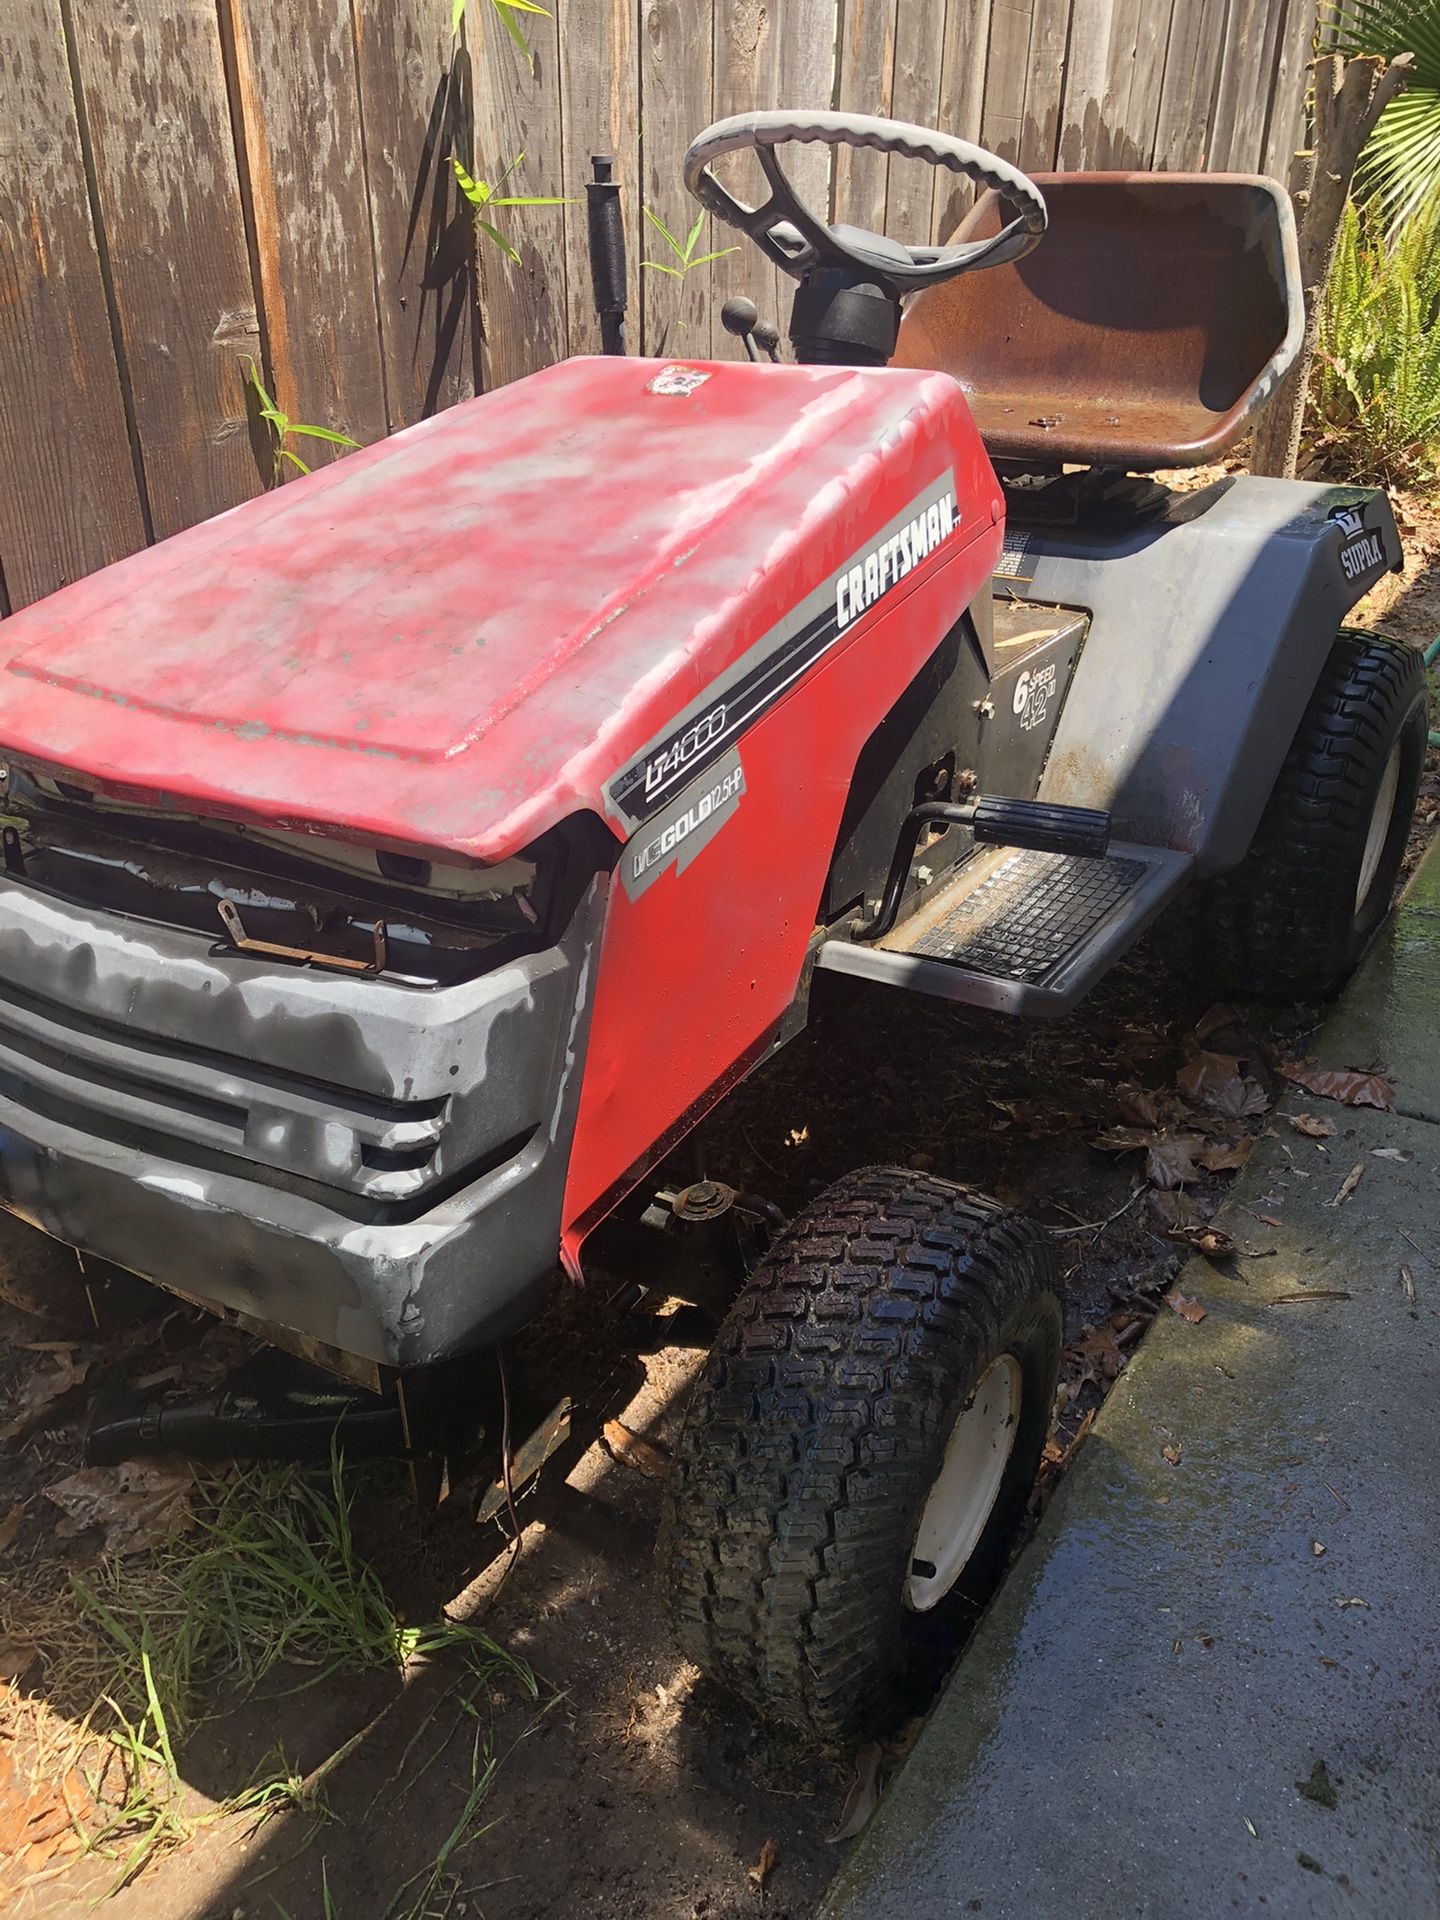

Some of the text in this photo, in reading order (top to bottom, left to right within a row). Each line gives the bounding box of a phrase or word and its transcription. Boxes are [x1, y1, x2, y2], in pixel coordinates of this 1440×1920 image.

[836, 492, 953, 629] CRAFTSMAN
[1341, 535, 1383, 580] SUPRA
[1013, 664, 1055, 714] 6 SPEED
